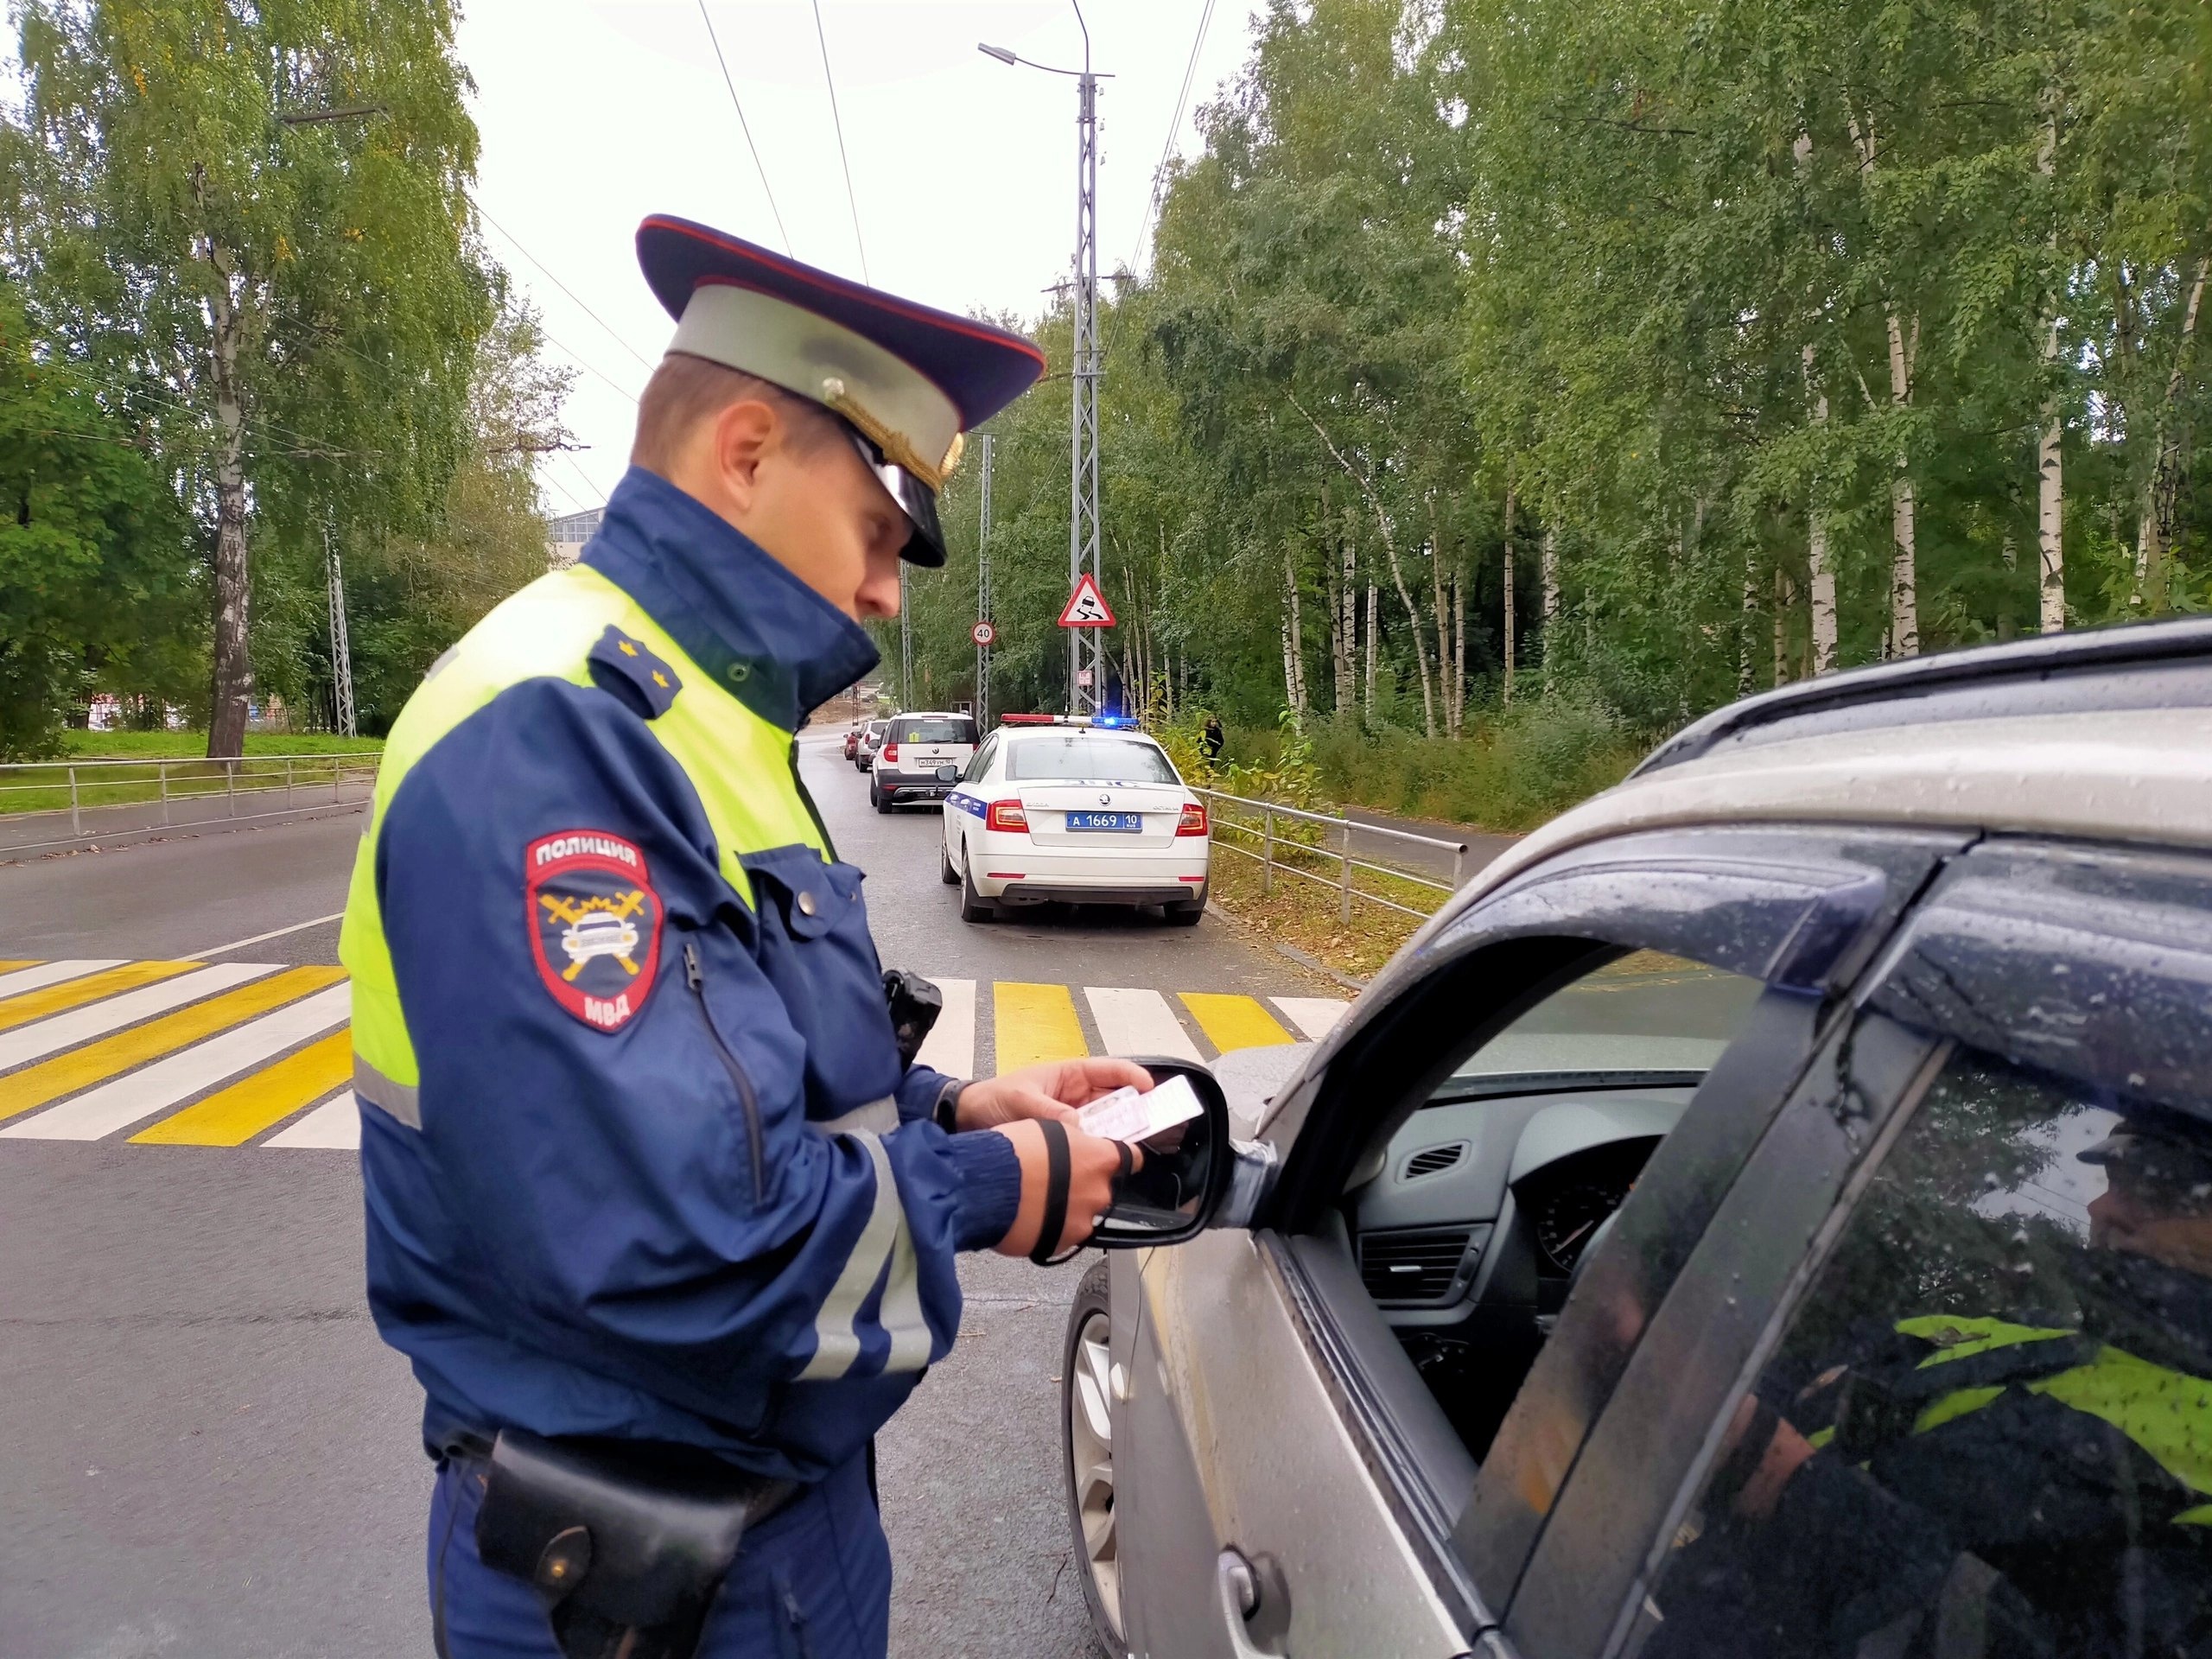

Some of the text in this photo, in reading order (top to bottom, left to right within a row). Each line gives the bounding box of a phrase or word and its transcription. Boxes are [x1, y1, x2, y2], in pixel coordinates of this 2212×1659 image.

[976, 628, 990, 639] 40
[1086, 814, 1117, 827] 1669
[1125, 815, 1137, 824] 10
[536, 836, 637, 868] ПОЛИЦИЯ
[584, 994, 631, 1027] МВД
